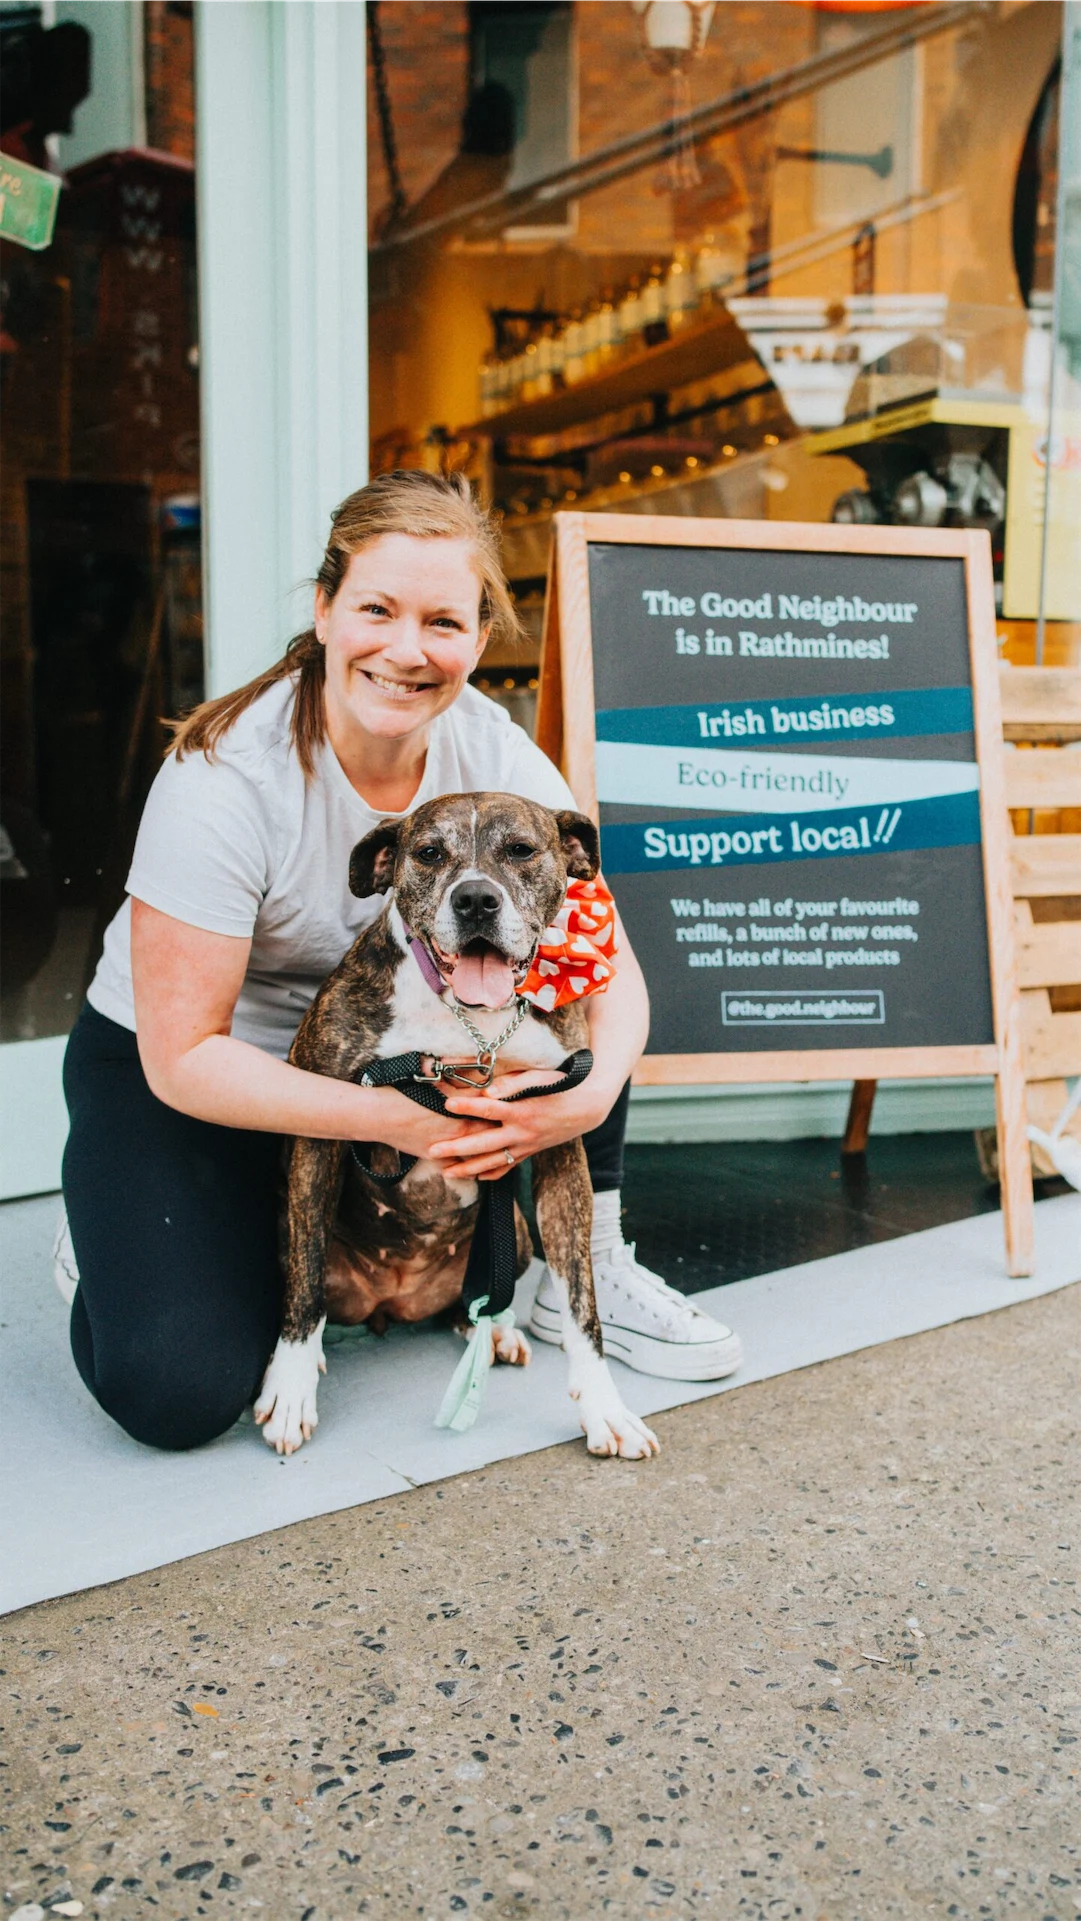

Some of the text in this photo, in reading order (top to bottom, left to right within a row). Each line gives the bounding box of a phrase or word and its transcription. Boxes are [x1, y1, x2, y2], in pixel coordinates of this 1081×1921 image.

[642, 590, 918, 627] The Good Neighbour
[675, 628, 890, 659] is in Rathmines!
[697, 703, 896, 737] Irish business
[677, 761, 850, 800] Eco-friendly
[643, 826, 784, 864] Support
[671, 897, 920, 921] We have all of your favourite
[676, 922, 918, 945] refills, a bunch of new ones,
[688, 948, 900, 969] and lots of local products
[727, 1000, 876, 1019] @the.good.neighbour
